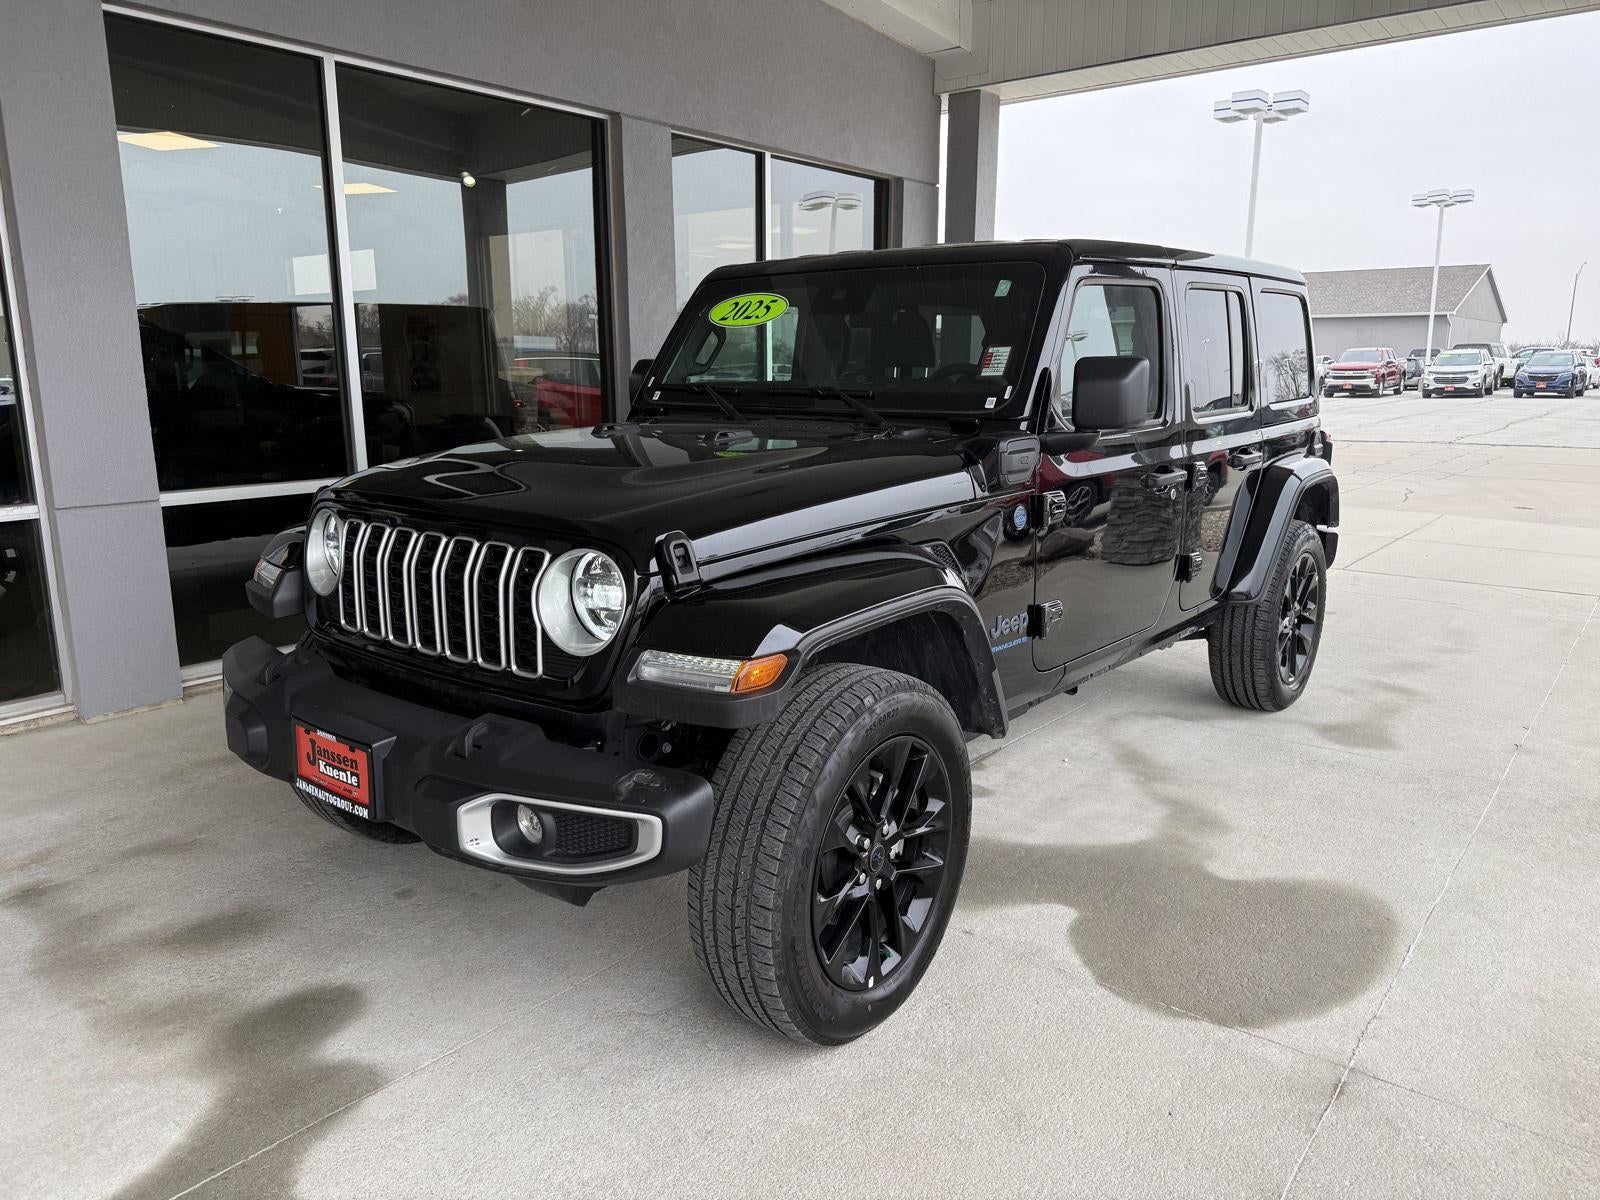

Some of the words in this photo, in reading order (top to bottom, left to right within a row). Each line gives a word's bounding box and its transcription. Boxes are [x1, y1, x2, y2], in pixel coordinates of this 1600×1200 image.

[718, 299, 779, 321] 2025
[990, 612, 1029, 640] Jeep
[306, 737, 359, 771] Janssen
[318, 759, 359, 787] Kuenle
[295, 777, 369, 820] JANSSENAUTOGROUP.COM
